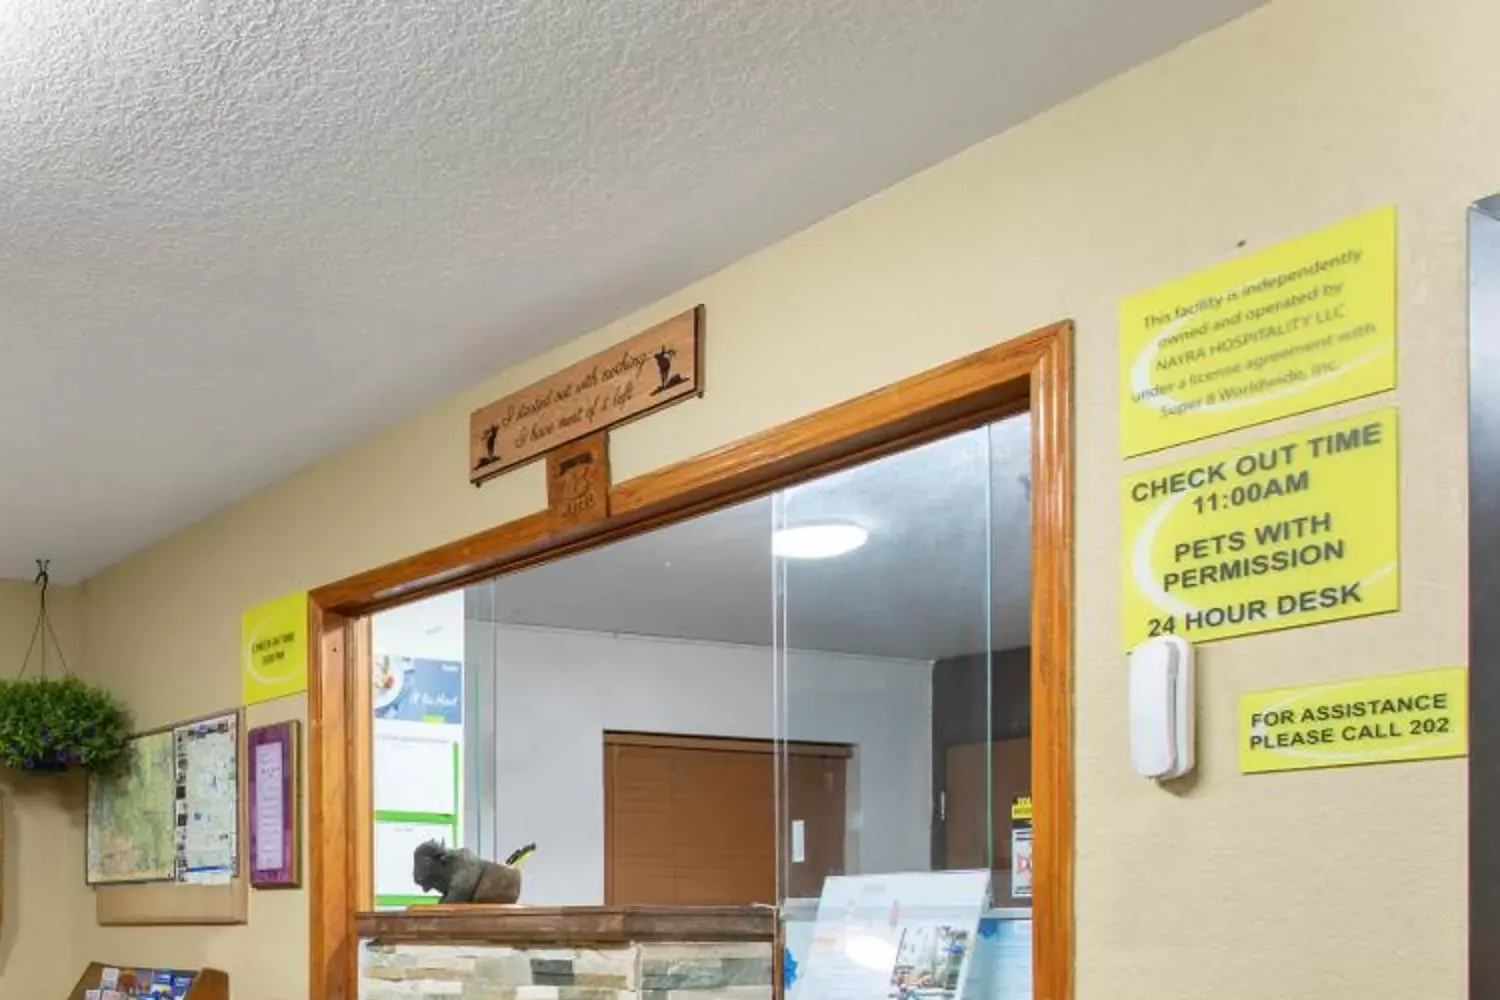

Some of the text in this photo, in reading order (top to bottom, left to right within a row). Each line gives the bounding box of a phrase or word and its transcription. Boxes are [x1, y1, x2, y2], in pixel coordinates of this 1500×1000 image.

[1143, 248, 1363, 329] This facility is independently
[1157, 282, 1345, 349] owned and operated by
[1131, 323, 1377, 403] under a license agreement with
[1155, 305, 1345, 372] NAYRA HOSPITALITY LLC
[1160, 398, 1204, 418] Super
[1131, 422, 1382, 502] CHECK OUT TIME
[1193, 470, 1310, 514] 11:00AM
[1174, 511, 1332, 563] PETS WITH
[1163, 539, 1345, 593] PERMISSION
[1147, 581, 1363, 639] 24 HOUR DESK
[1250, 716, 1450, 750] PLEASE CALL 202
[1251, 692, 1448, 729] FOR ASSISTANCE
